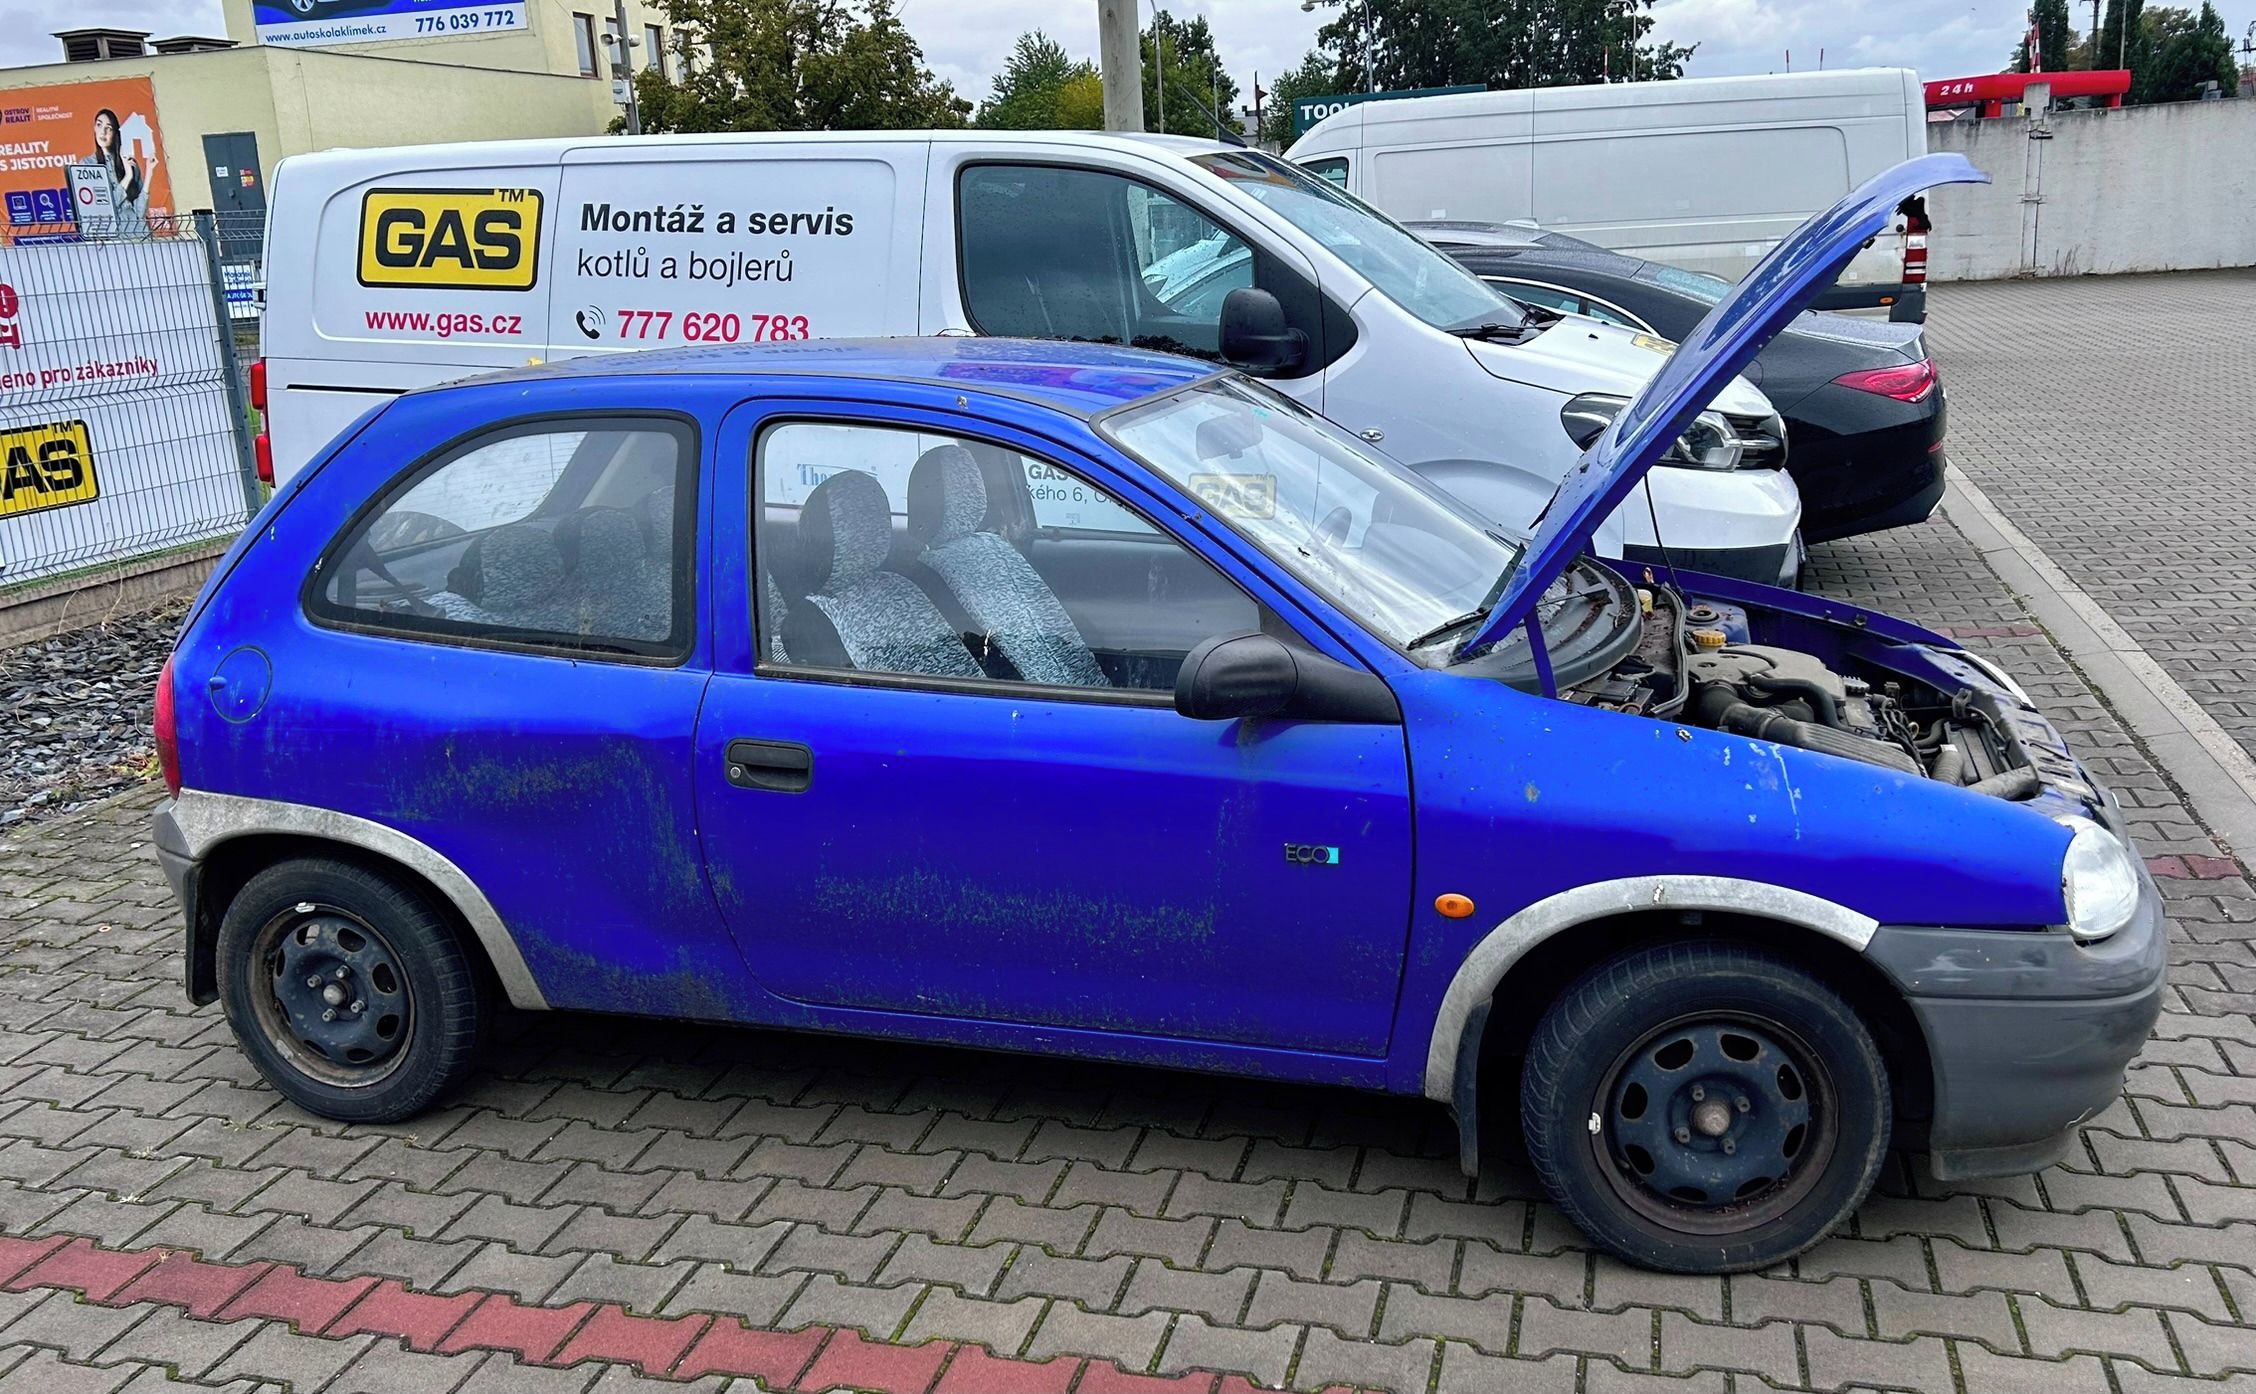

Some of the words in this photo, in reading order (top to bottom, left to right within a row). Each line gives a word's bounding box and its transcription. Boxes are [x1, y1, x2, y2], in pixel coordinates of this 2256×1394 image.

[266, 24, 387, 43] www.autoskolaklimek.cz
[415, 17, 445, 33] 776
[450, 14, 479, 30] 039
[484, 10, 515, 26] 772
[0, 140, 50, 156] REALITY
[0, 159, 8, 171] S
[10, 154, 77, 171] JISTOTOU!
[76, 168, 103, 180] ZÓNA
[498, 189, 525, 203] TM
[580, 203, 705, 235] Montáž
[716, 210, 736, 234] a
[747, 206, 854, 235] servis
[376, 208, 522, 270] GAS
[577, 246, 650, 278] kotlů
[660, 256, 678, 279] a
[688, 248, 794, 288] bojlerů
[365, 311, 523, 337] www.gas.cz
[617, 310, 673, 340] 777
[682, 311, 741, 341] 620
[751, 314, 810, 341] 783
[0, 372, 36, 388] eno
[40, 367, 71, 388] pro
[76, 355, 158, 381] zákazníky
[0, 439, 83, 499] AS
[1073, 487, 1087, 504] 6,
[1197, 482, 1267, 511] GAS
[1285, 844, 1330, 863] ECO
